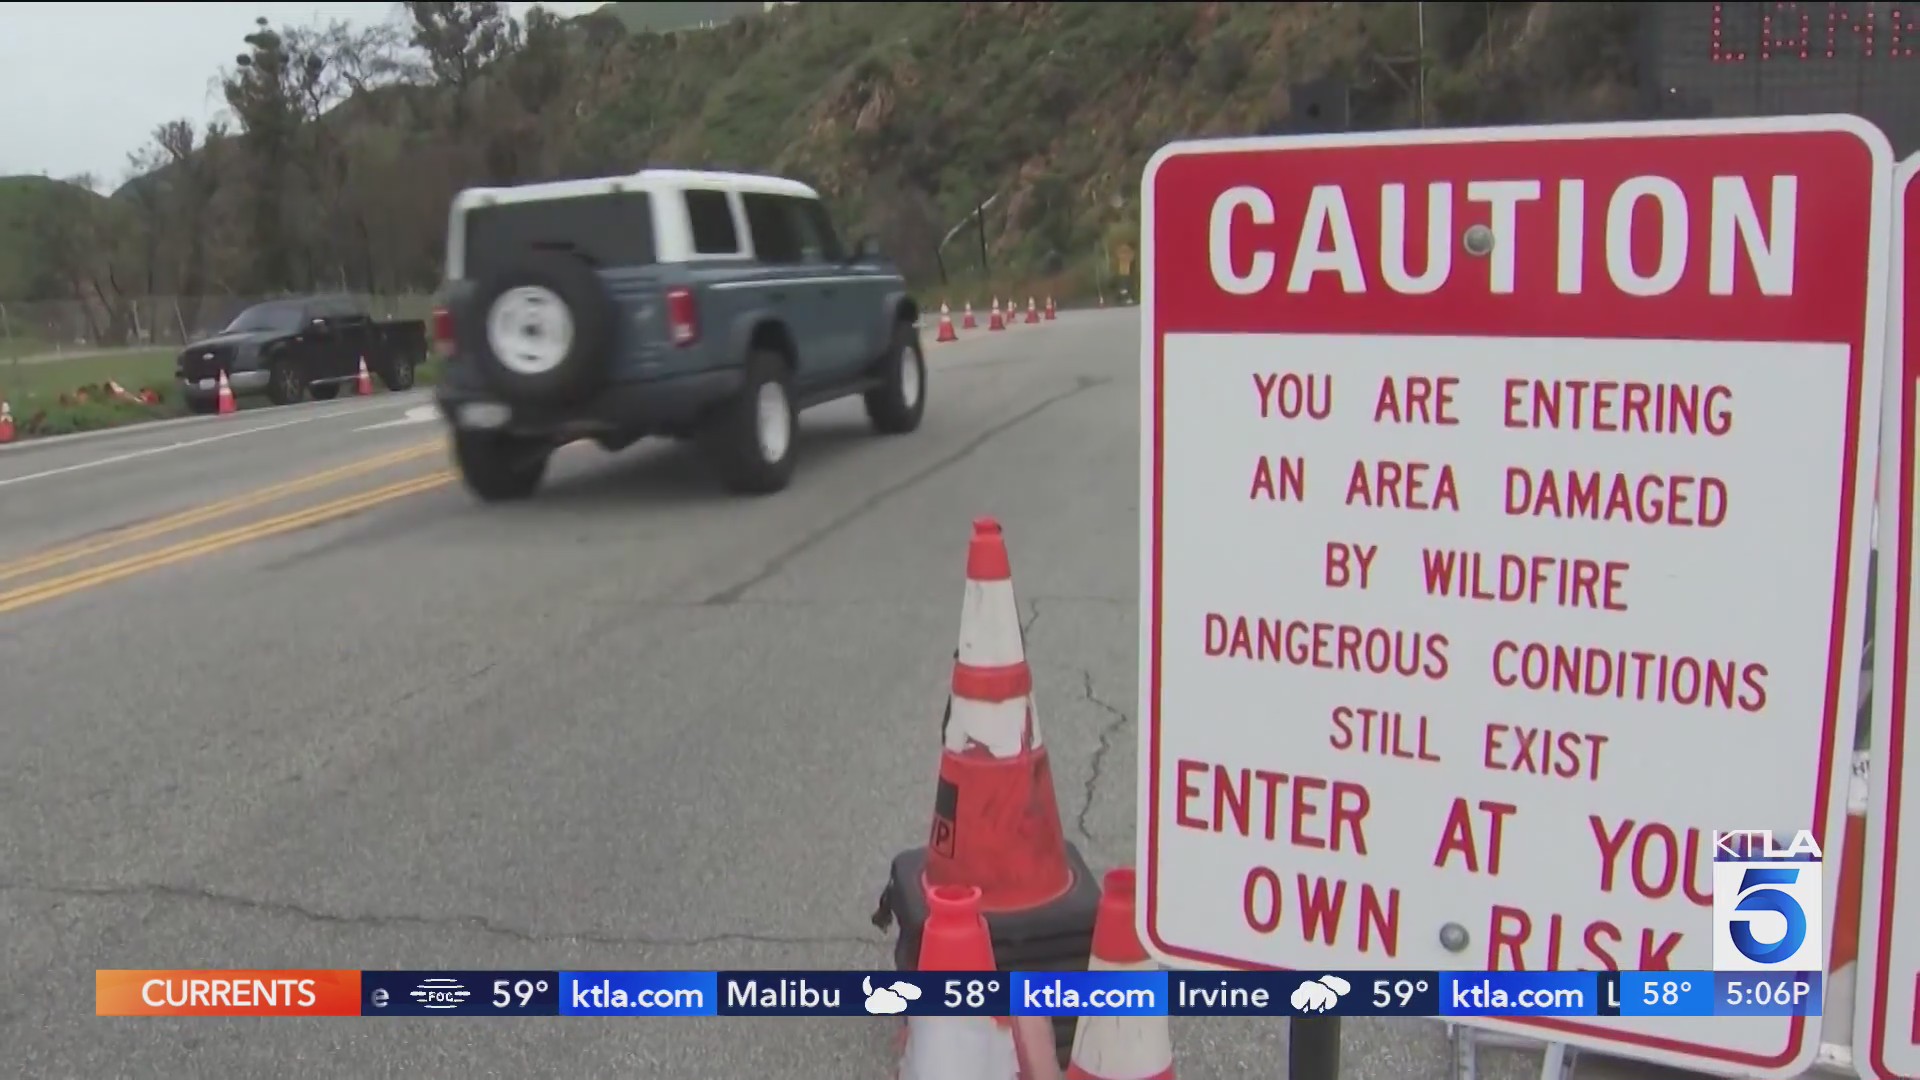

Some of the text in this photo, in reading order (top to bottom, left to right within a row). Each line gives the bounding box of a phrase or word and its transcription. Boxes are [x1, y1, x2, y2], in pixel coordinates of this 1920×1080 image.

[1209, 175, 1797, 296] CAUTION
[1252, 373, 1733, 436] YOU ARE ENTERING
[1250, 456, 1728, 527] AN AREA DAMAGED
[1324, 541, 1630, 612] BY WILDFIRE
[1204, 612, 1768, 712] DANGEROUS CONDITIONS
[1330, 706, 1608, 781] STILL EXIST
[1175, 759, 1714, 907] ENTER AT YOU
[1243, 866, 1685, 972] OWN RISK
